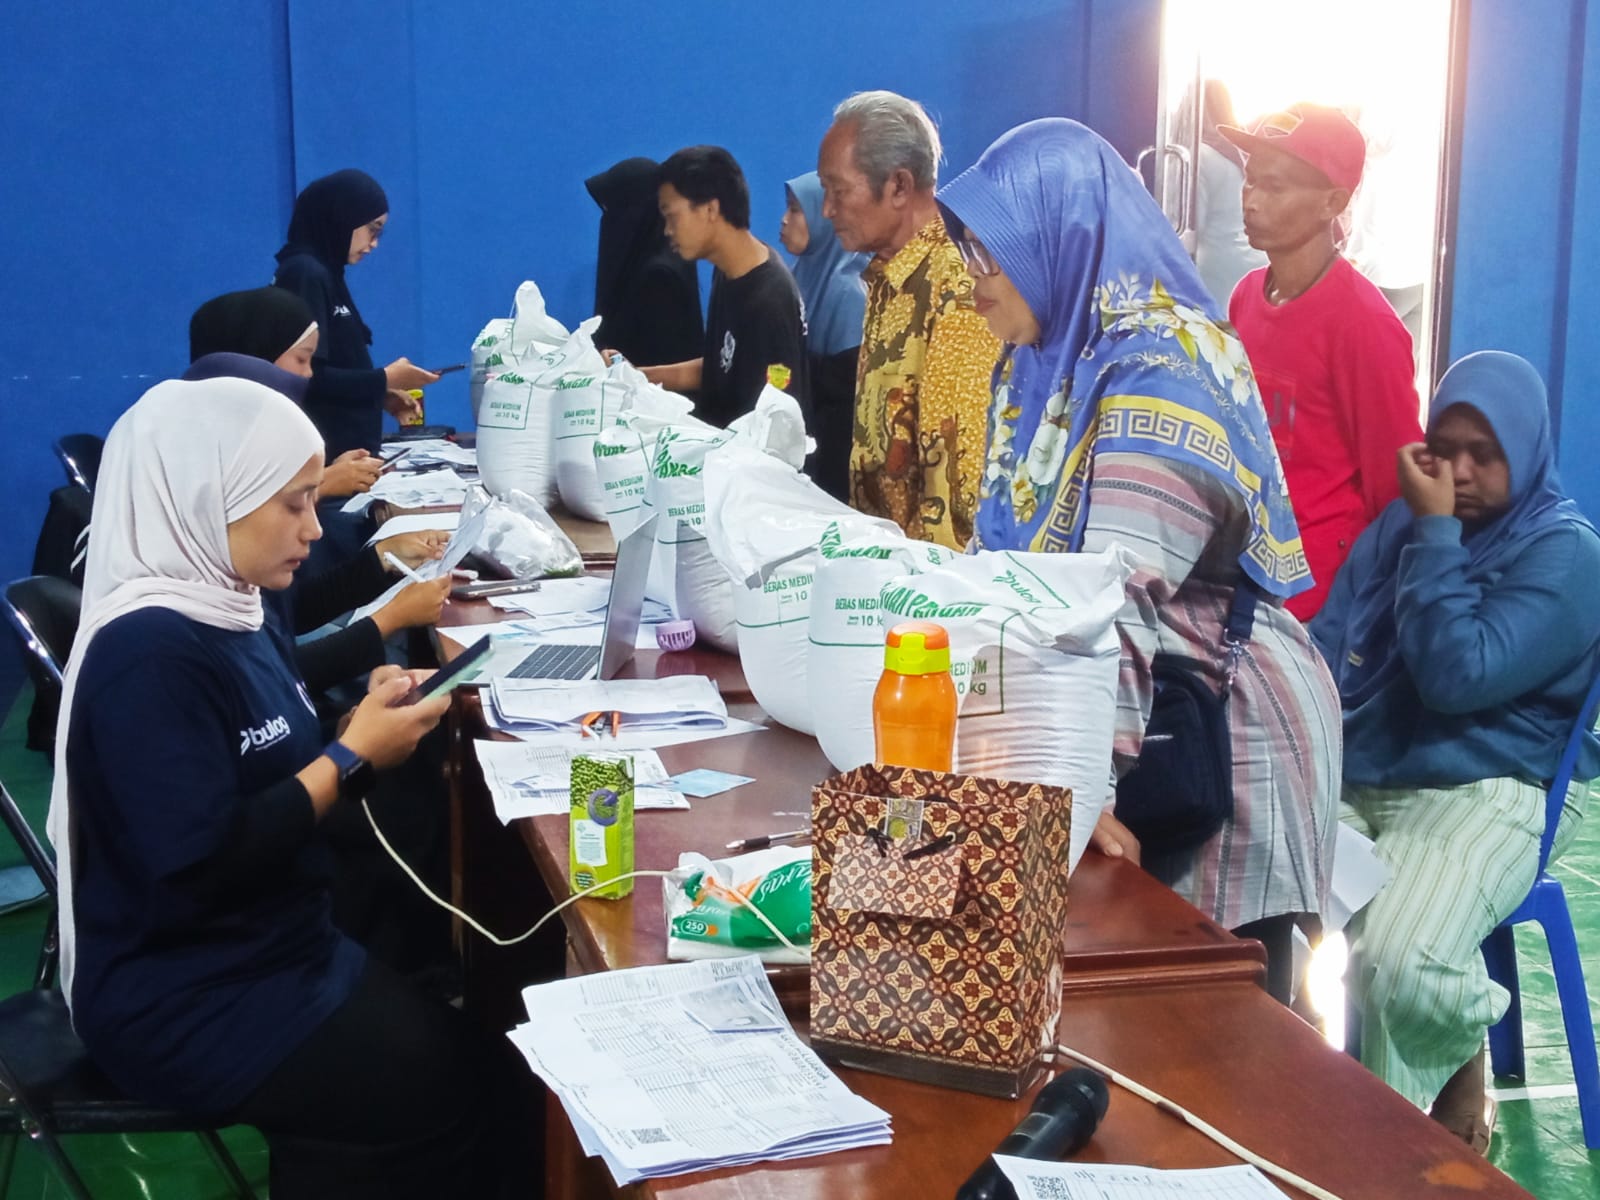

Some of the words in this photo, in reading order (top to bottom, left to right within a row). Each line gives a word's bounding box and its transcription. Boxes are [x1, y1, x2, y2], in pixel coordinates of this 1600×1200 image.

[763, 580, 788, 593] BERAS
[795, 590, 808, 601] 10
[835, 598, 856, 610] BERAS
[861, 615, 873, 626] 10
[877, 616, 885, 626] k
[969, 680, 986, 696] kg
[248, 715, 291, 745] bulog
[685, 921, 704, 931] 250
